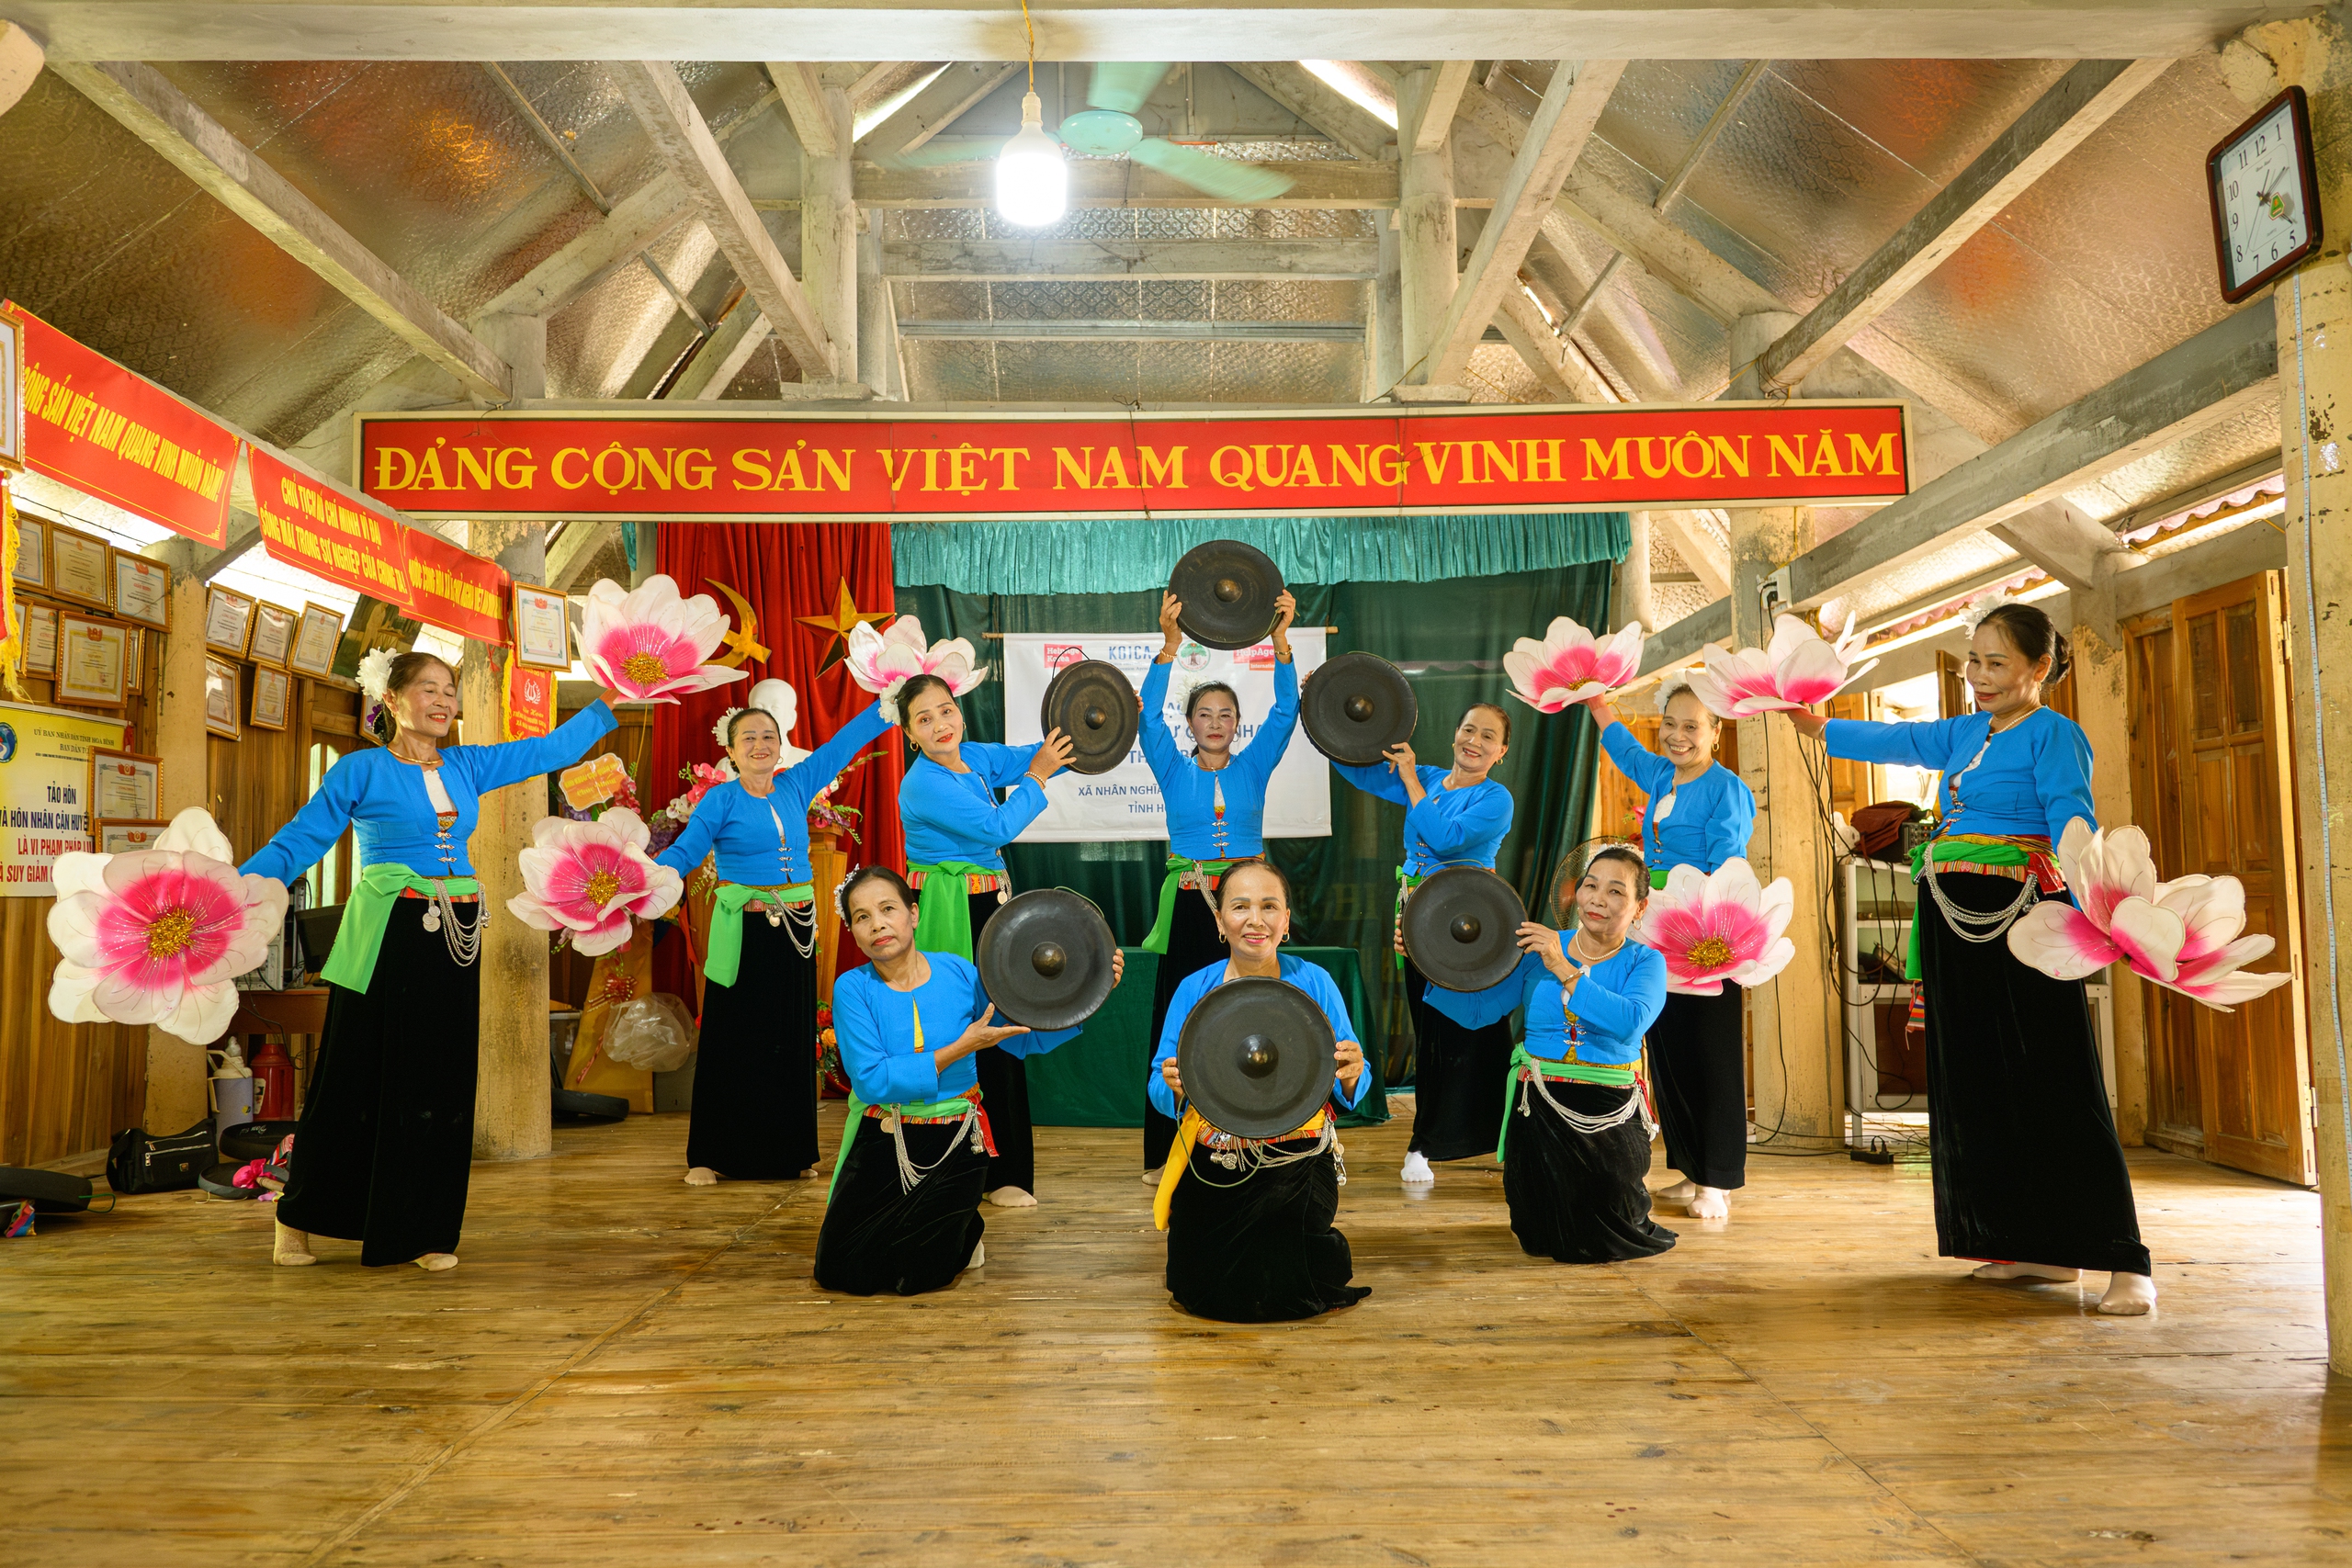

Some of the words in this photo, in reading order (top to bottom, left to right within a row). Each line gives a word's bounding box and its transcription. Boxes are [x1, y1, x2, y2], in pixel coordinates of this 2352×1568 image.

[2276, 123, 2281, 141] 1
[2255, 135, 2267, 157] 12
[2238, 149, 2248, 170] 11
[2228, 180, 2239, 202] 10
[2232, 212, 2239, 231] 9
[2290, 230, 2296, 249] 5
[2236, 244, 2243, 263] 8
[2271, 241, 2278, 261] 6
[2253, 254, 2259, 273] 7
[63, 392, 98, 443] VIỆT
[87, 406, 128, 452] NAM
[118, 422, 160, 469] QUANG
[153, 438, 180, 479] VINH
[175, 449, 205, 491] MUÔN
[374, 437, 537, 490] ĐẢNG
[551, 442, 717, 495] CỘNG
[732, 440, 856, 491] SẢN
[876, 443, 1030, 496] VIỆT
[1052, 446, 1189, 491] NAM
[1210, 445, 1410, 491] QUANG
[1413, 440, 1566, 484] VINH
[1581, 432, 1751, 480] MUÔN
[1766, 431, 1900, 477] NĂM
[338, 505, 361, 537] MINH
[296, 525, 322, 560] TRONG
[1108, 645, 1152, 660] KOICA
[1236, 647, 1275, 658] HelpAge
[47, 781, 62, 804] TẢO
[62, 784, 76, 805] HÔN
[1078, 784, 1092, 796] XÃ
[1095, 784, 1126, 795] NHÂN
[1128, 800, 1154, 813] TỈNH
[11, 807, 28, 828] HÔN
[31, 808, 54, 829] NHÂN
[55, 810, 70, 834] CẬN
[72, 811, 90, 831] HUYẾ
[17, 834, 28, 855] LÀ
[30, 838, 39, 855] VI
[40, 838, 63, 860] PHẠM
[6, 864, 25, 883] SUY
[27, 859, 49, 883] GIẢM
